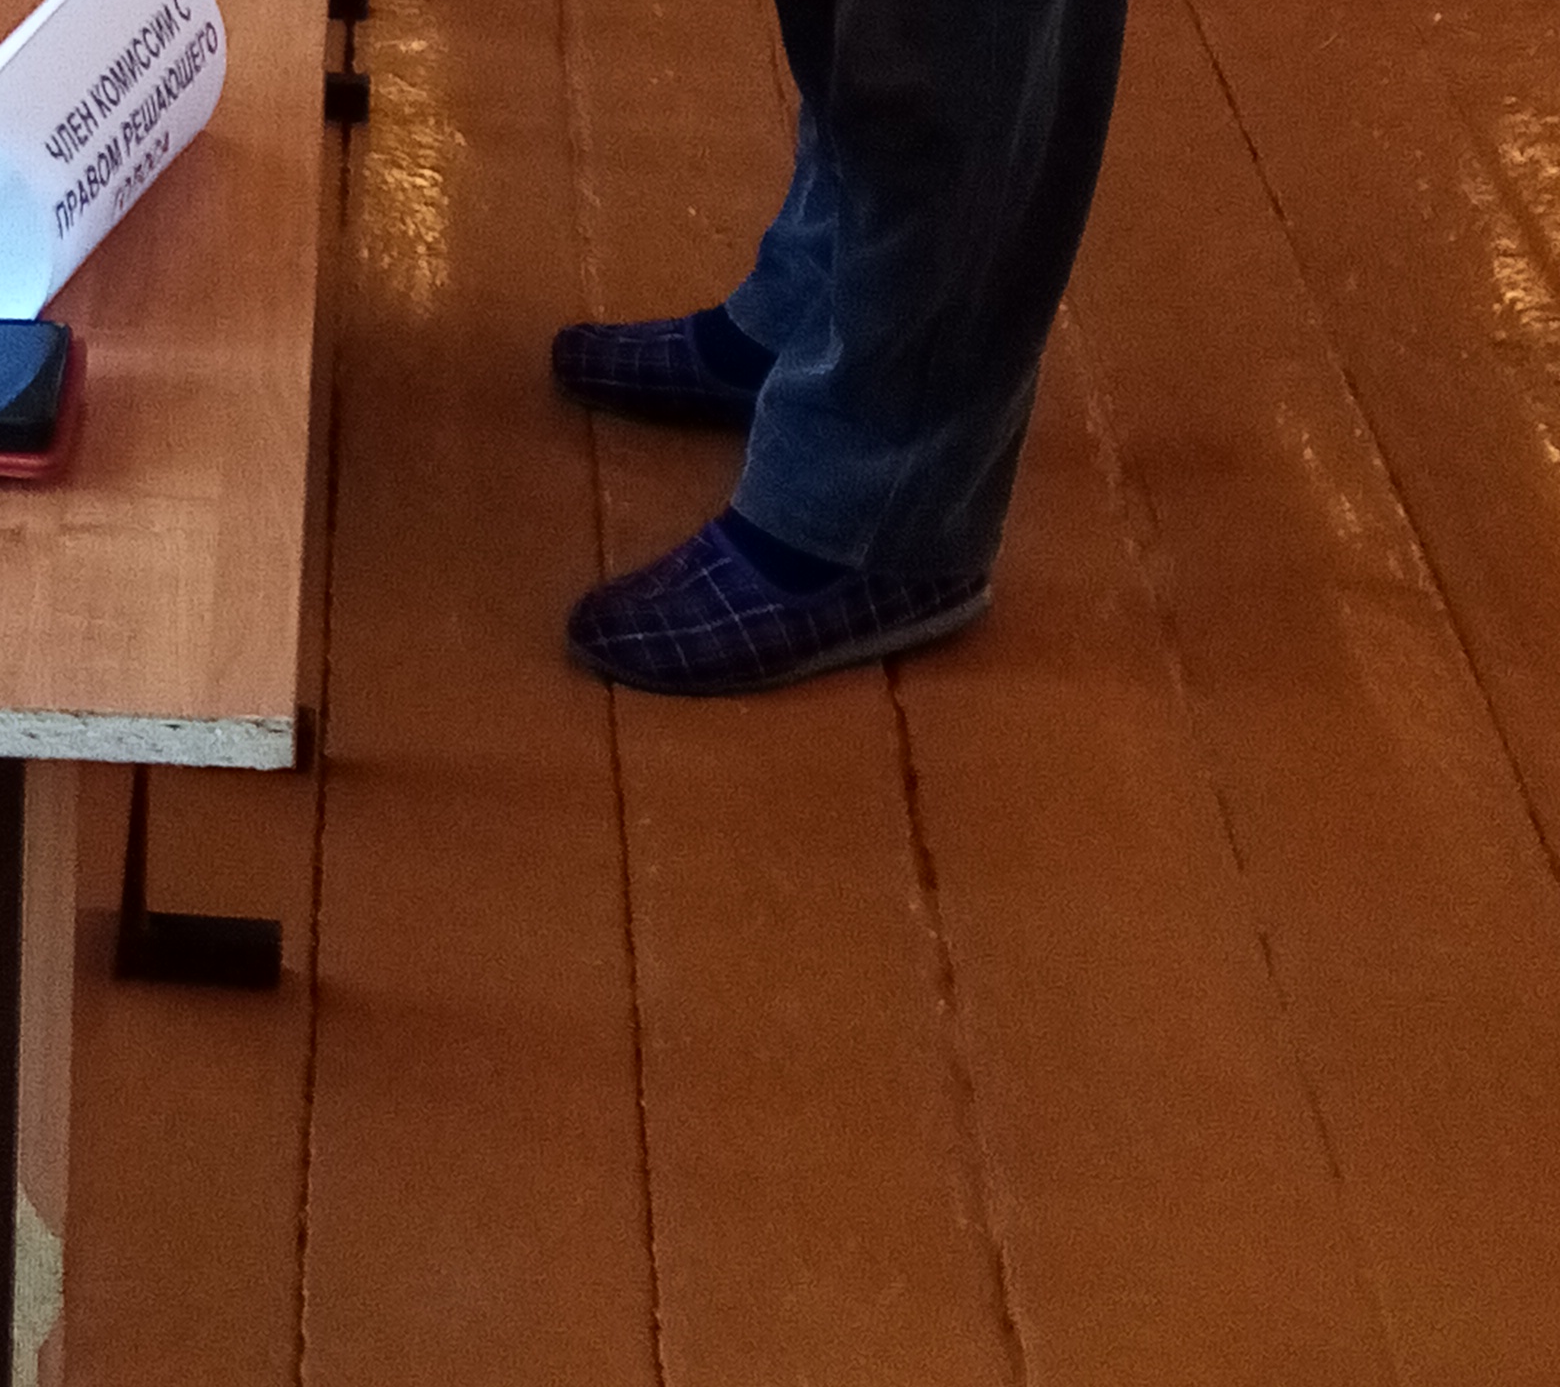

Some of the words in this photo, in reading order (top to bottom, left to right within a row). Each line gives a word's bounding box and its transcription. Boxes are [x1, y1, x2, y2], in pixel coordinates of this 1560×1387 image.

[44, 98, 100, 164] ЧЛЕН
[90, 3, 181, 119] КОМИССИИ
[54, 131, 123, 240] ПРАВОМ
[121, 21, 219, 157] РЕШАЮЩЕГО
